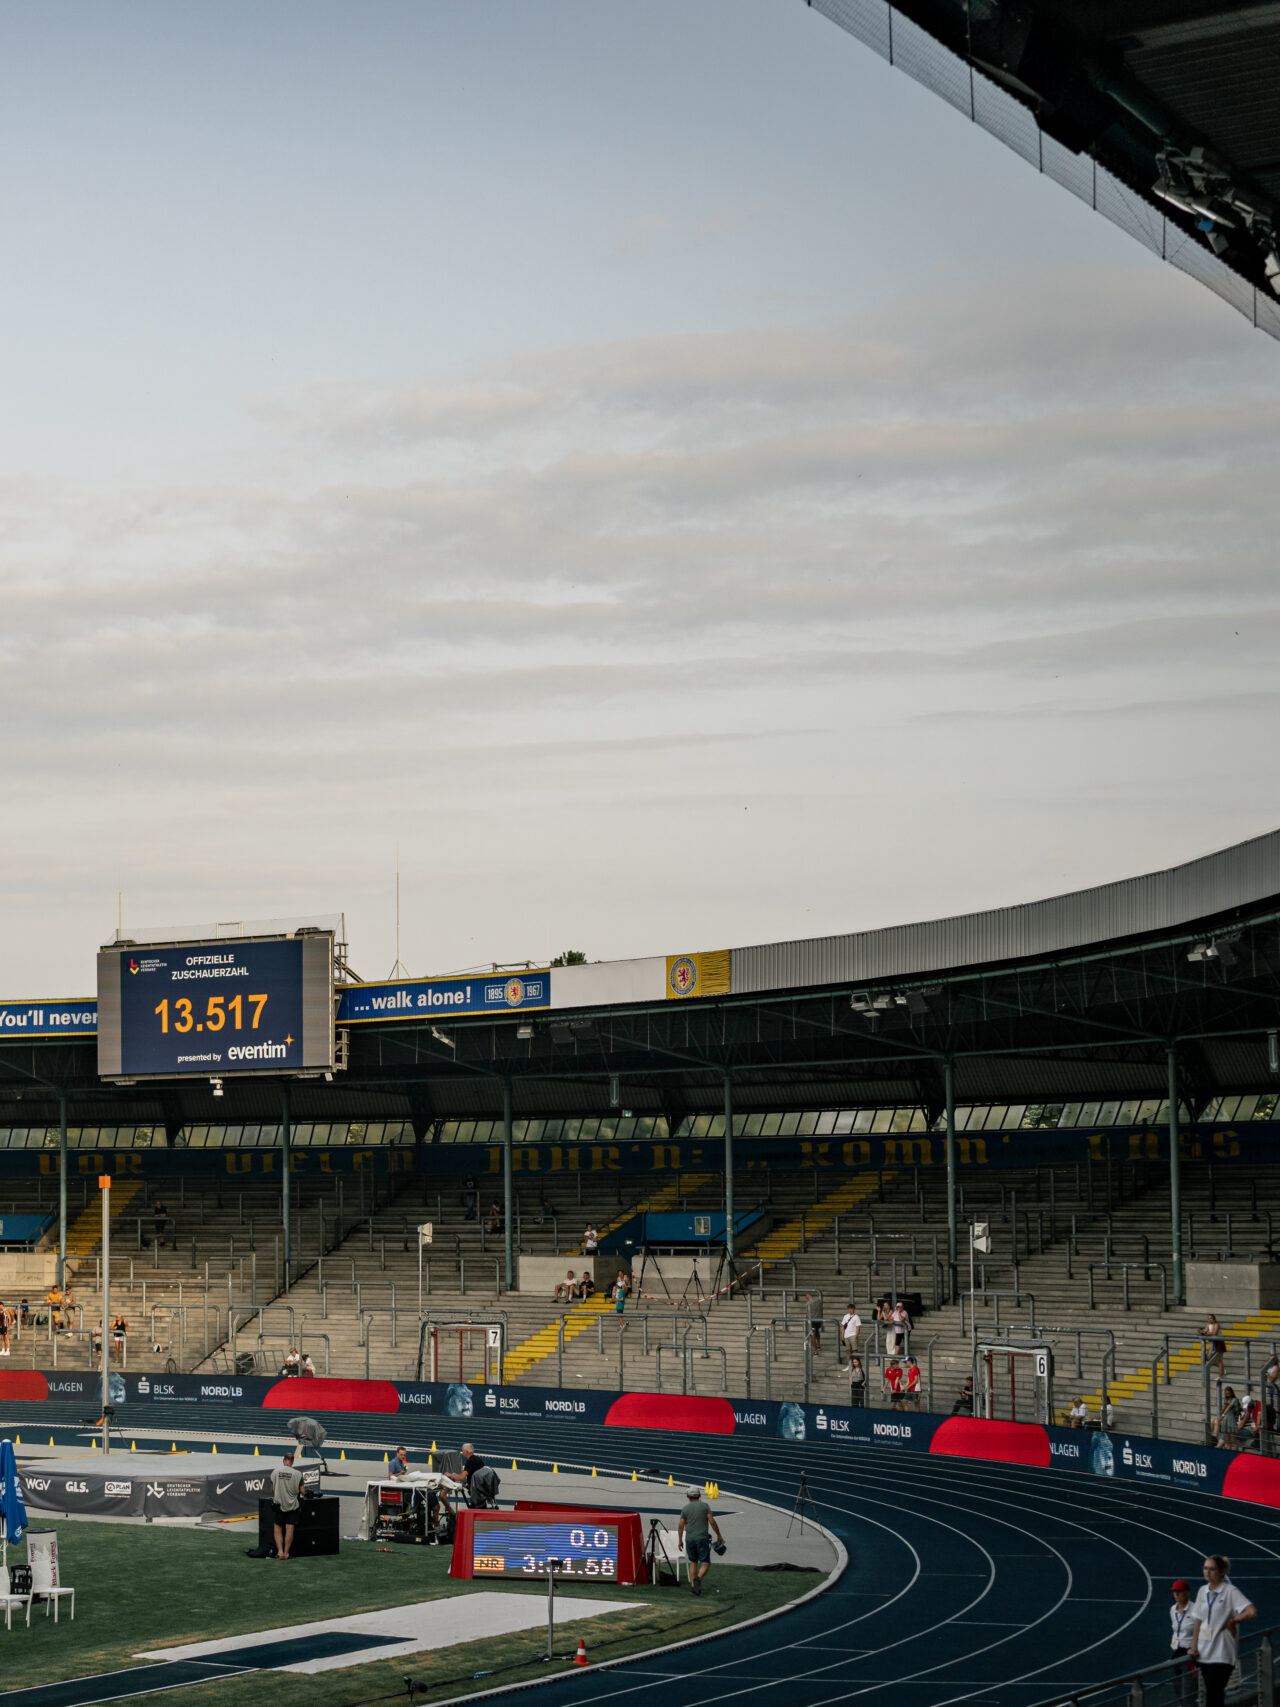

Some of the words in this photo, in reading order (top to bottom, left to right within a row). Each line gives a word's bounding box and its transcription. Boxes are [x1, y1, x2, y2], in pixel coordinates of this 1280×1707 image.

[186, 954, 234, 966] OFFIZIELLE
[171, 967, 249, 980] ZUSCHAUERZAHL
[417, 985, 471, 1007] alone!
[487, 987, 503, 1000] 1895
[527, 985, 540, 998] 1967
[49, 1012, 98, 1026] never
[154, 994, 268, 1034] 13.517
[177, 1053, 212, 1063] presented
[212, 1052, 222, 1062] by
[228, 1040, 286, 1060] eventim
[491, 1332, 498, 1345] 7
[1038, 1358, 1045, 1374] 6
[154, 1384, 175, 1395] BLSK
[201, 1386, 243, 1397] NORD/LB
[500, 1398, 520, 1409] BLSK
[545, 1400, 586, 1413] NORD/LB
[830, 1420, 849, 1432] BLSK
[873, 1422, 912, 1438] NORD/LB
[1135, 1453, 1153, 1469] BLSK
[1172, 1458, 1207, 1477] NORD/LB
[25, 1478, 51, 1490] WGV
[66, 1481, 89, 1493] GLS.
[244, 1479, 265, 1492] WGV
[570, 1529, 609, 1548] 0.0
[480, 1559, 499, 1569] NR
